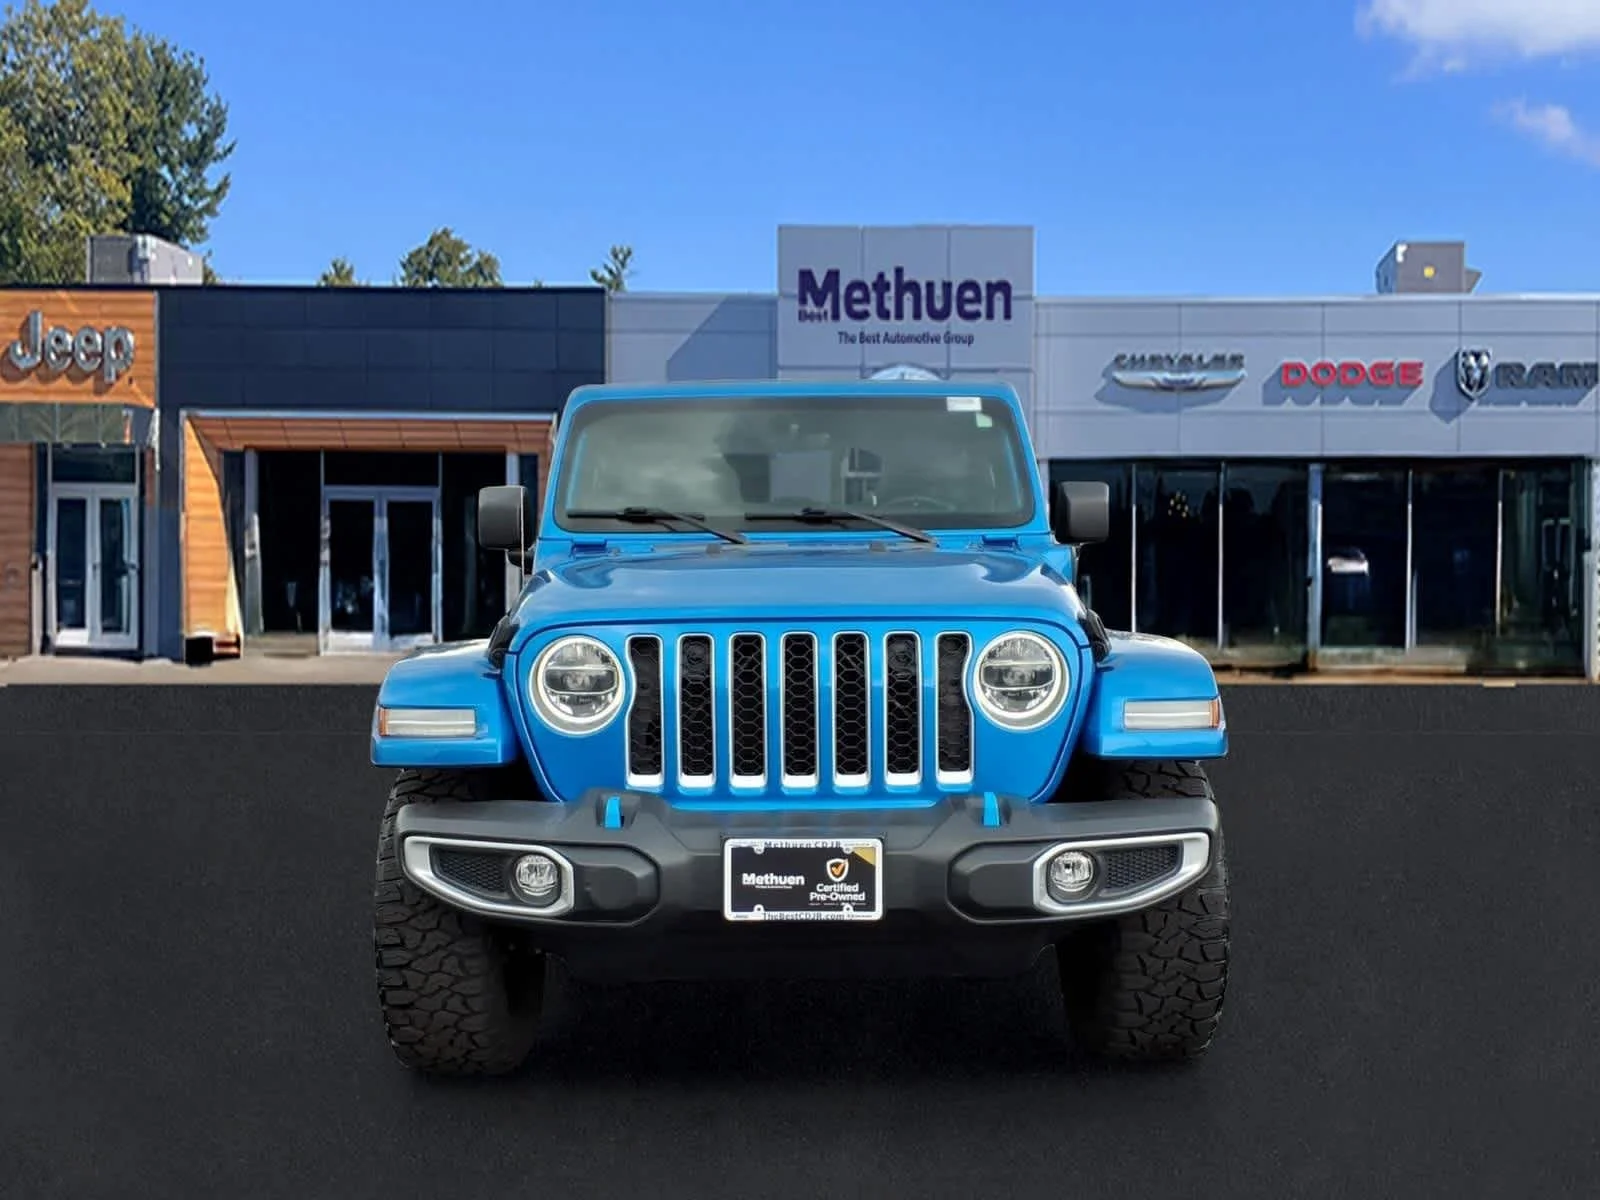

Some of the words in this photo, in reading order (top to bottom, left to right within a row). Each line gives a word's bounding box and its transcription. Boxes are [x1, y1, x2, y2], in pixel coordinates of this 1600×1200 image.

[798, 266, 1012, 321] Methuen
[9, 310, 135, 384] Jeep
[837, 330, 857, 345] The
[858, 330, 881, 345] Best
[882, 330, 942, 345] Automotive
[942, 330, 975, 347] Group
[1113, 353, 1245, 369] CHRYSLER
[1280, 360, 1424, 387] DODGE
[1495, 361, 1600, 389] RAM
[742, 873, 804, 885] Methuen
[816, 883, 859, 892] Certified
[809, 892, 866, 902] Pre-Owned
